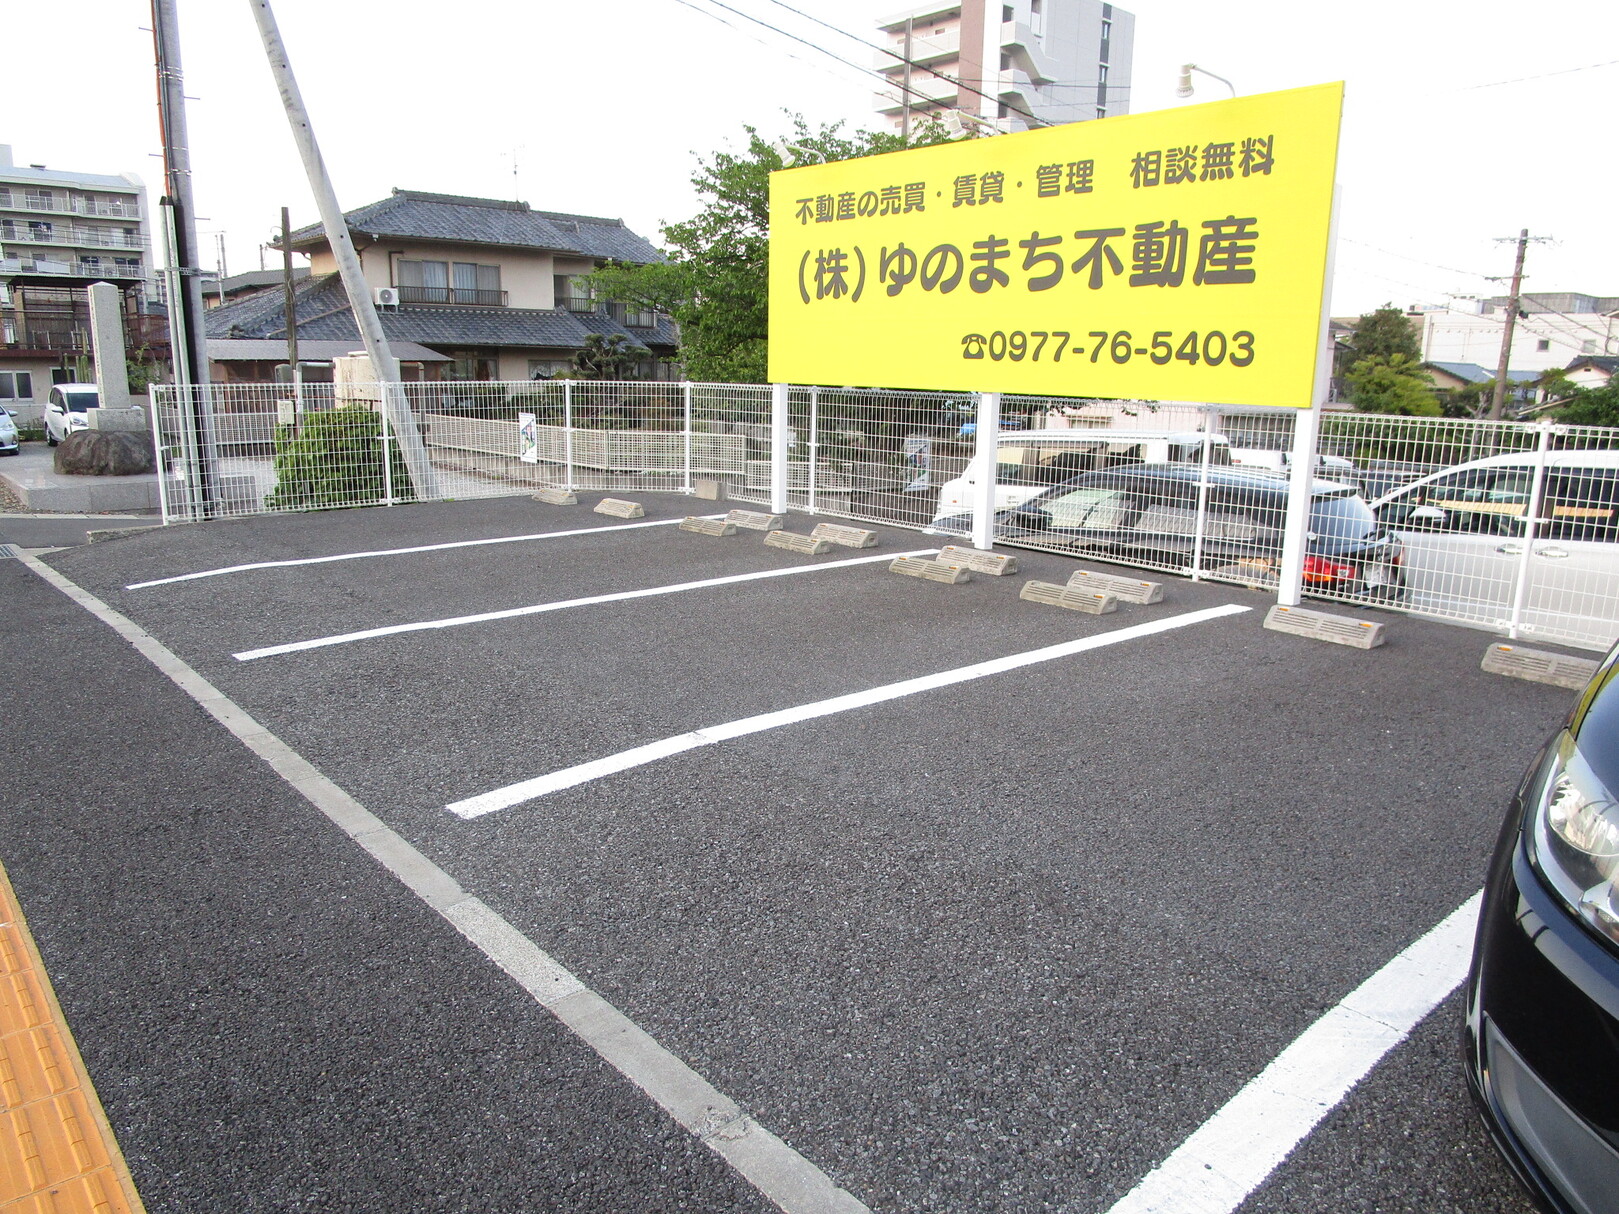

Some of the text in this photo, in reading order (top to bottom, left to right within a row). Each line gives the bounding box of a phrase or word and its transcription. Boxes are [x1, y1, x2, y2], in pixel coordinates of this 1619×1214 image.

[795, 135, 1275, 226] 不動産の売買・賃貸・管理 相談無料
[798, 215, 1260, 305] (株)ゆのまち不動産
[988, 330, 1255, 368] 0977-76-5403
